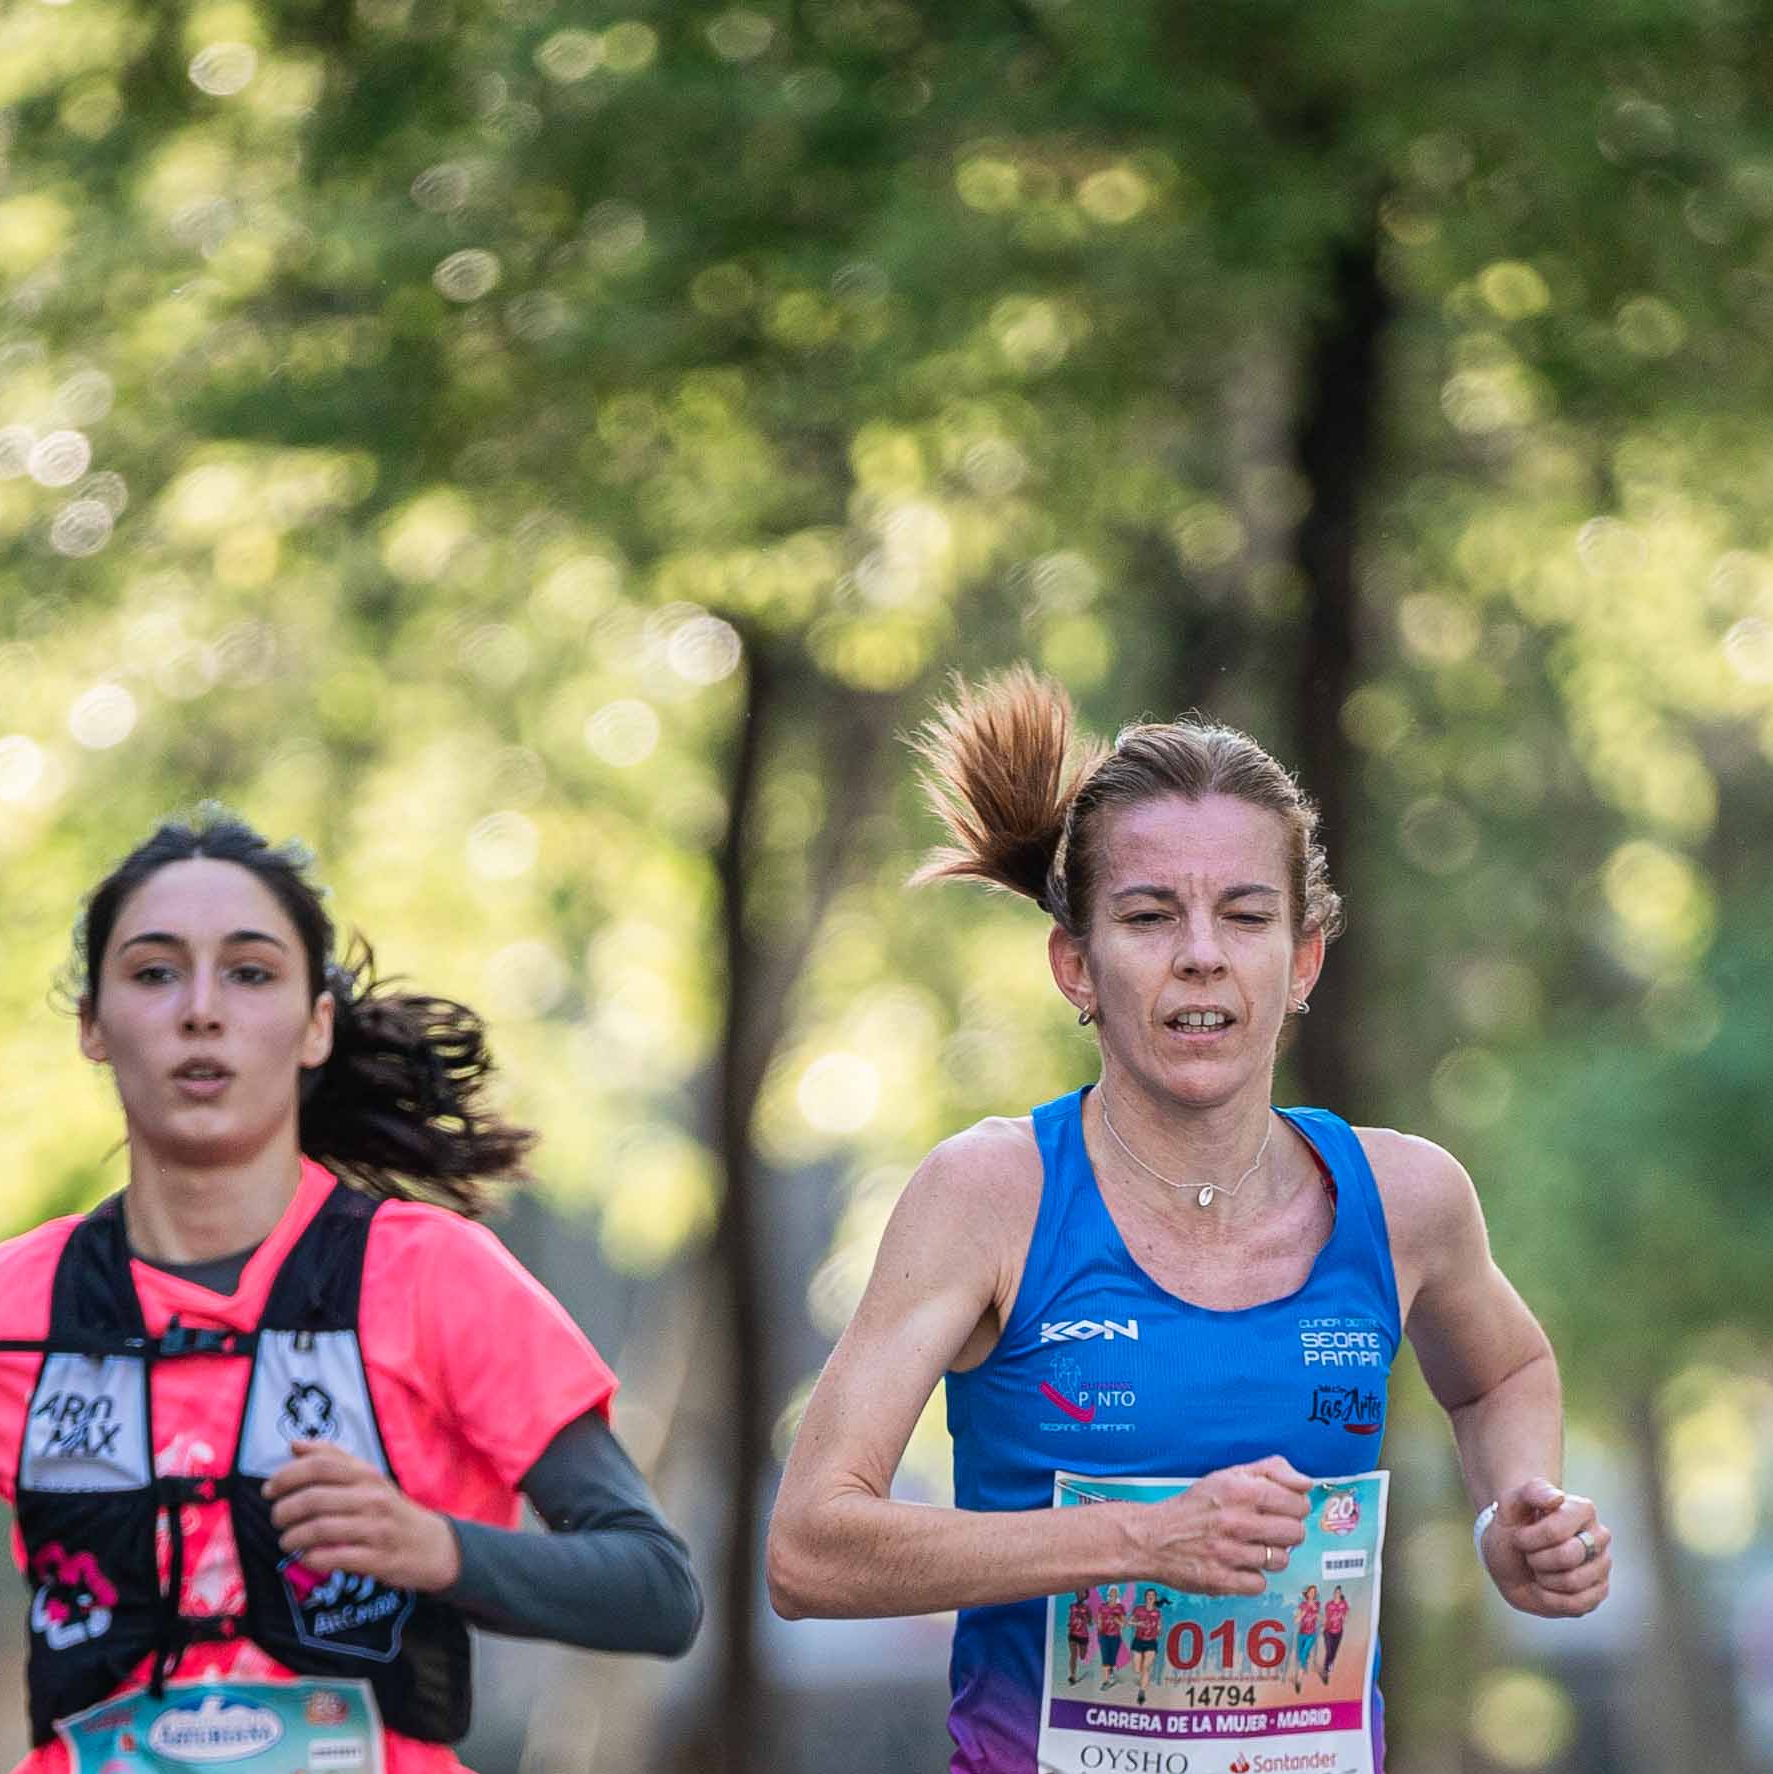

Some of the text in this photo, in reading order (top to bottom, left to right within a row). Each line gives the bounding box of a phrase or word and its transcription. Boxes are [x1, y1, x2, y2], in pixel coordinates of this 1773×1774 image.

[1078, 1391, 1137, 1408] PNTO
[1166, 1619, 1287, 1671] 016
[1185, 1685, 1256, 1708] 14794
[1086, 1708, 1332, 1734] CARRERA DE LA MUJER MADRID
[1253, 1751, 1338, 1774] Santander
